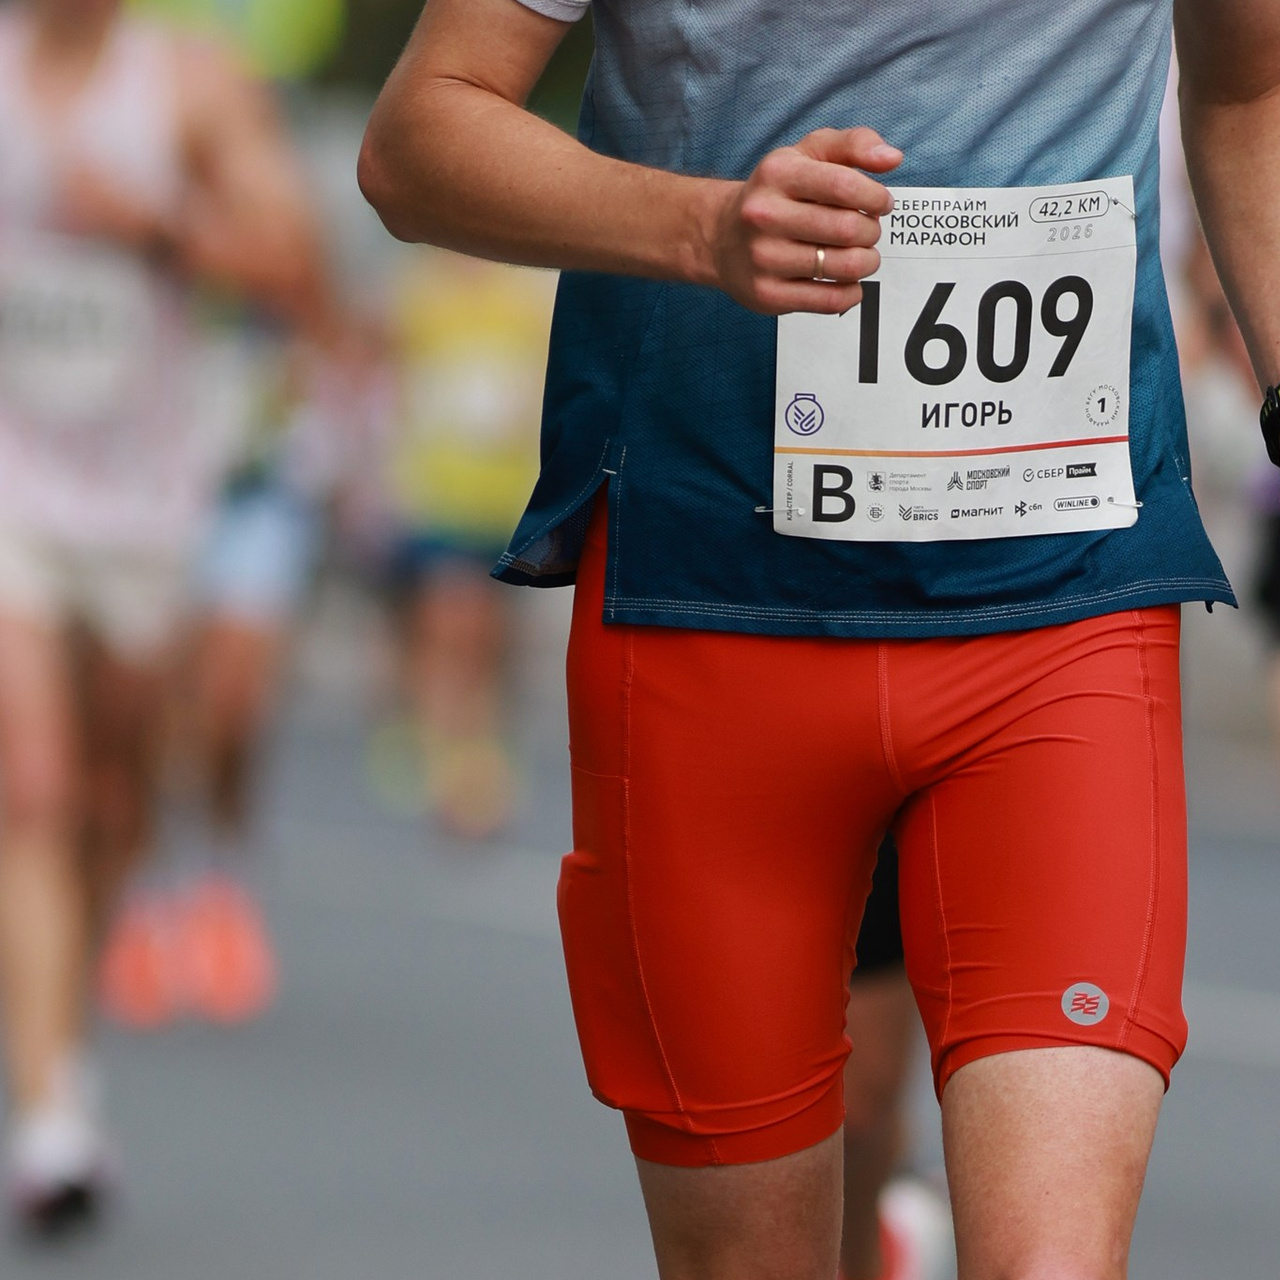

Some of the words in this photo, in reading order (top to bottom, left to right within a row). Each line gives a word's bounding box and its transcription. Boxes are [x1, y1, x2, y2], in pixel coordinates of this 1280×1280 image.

[893, 198, 987, 211] СБЕРПРАЙМ
[1039, 200, 1073, 218] 42,2
[1078, 197, 1100, 213] КМ
[890, 211, 1019, 228] МОСКОВСКИЙ
[889, 231, 986, 246] МАРАФОН
[1047, 224, 1093, 242] 2026
[839, 275, 1094, 386] 1609
[1097, 397, 1106, 413] 1
[921, 401, 1013, 429] ИГОРЬ
[967, 466, 1010, 480] МОСКОВСКИЙ
[1037, 468, 1064, 479] СБЕР
[1068, 467, 1092, 475] Прайм
[966, 480, 988, 491] СПОРТ
[812, 464, 856, 523] B
[1057, 499, 1090, 508] WINLINE
[913, 513, 939, 521] BRICS
